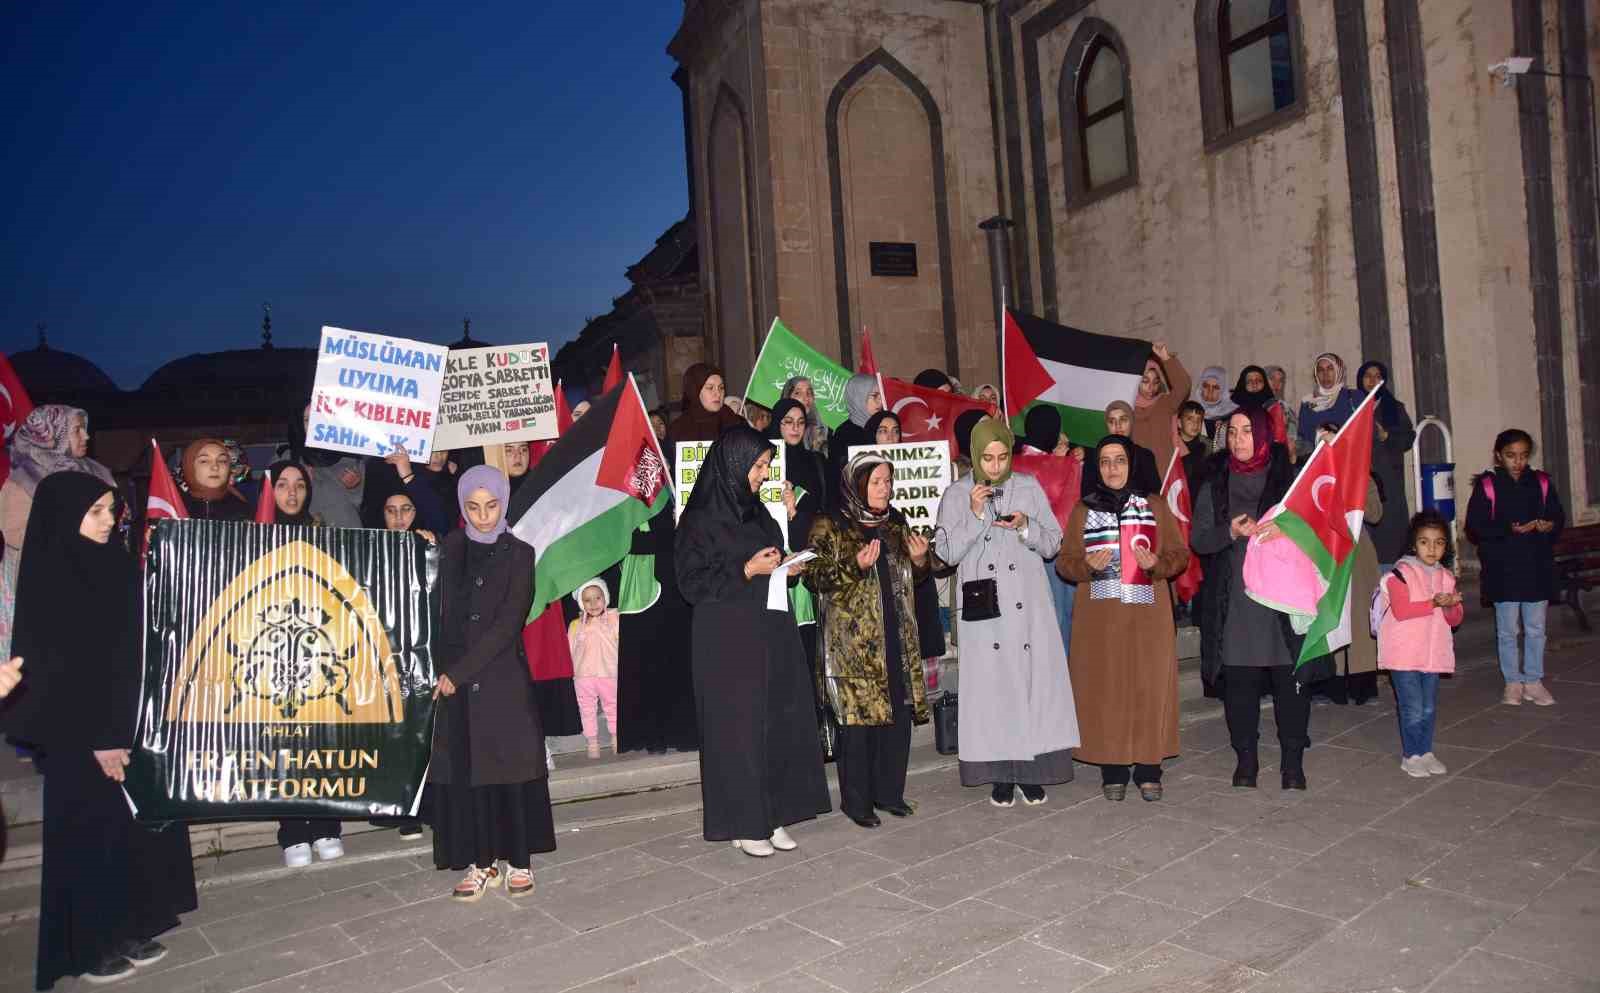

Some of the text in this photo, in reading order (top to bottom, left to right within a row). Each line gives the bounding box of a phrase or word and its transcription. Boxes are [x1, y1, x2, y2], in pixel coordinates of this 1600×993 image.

[325, 335, 442, 372] MÜSLÜMAN
[445, 356, 478, 374] KLE
[338, 367, 419, 399] UYUMA
[441, 372, 484, 391] SOFYA
[353, 400, 432, 429] KIBLENE
[261, 725, 313, 738] AHLAT
[284, 748, 379, 770] HATUN
